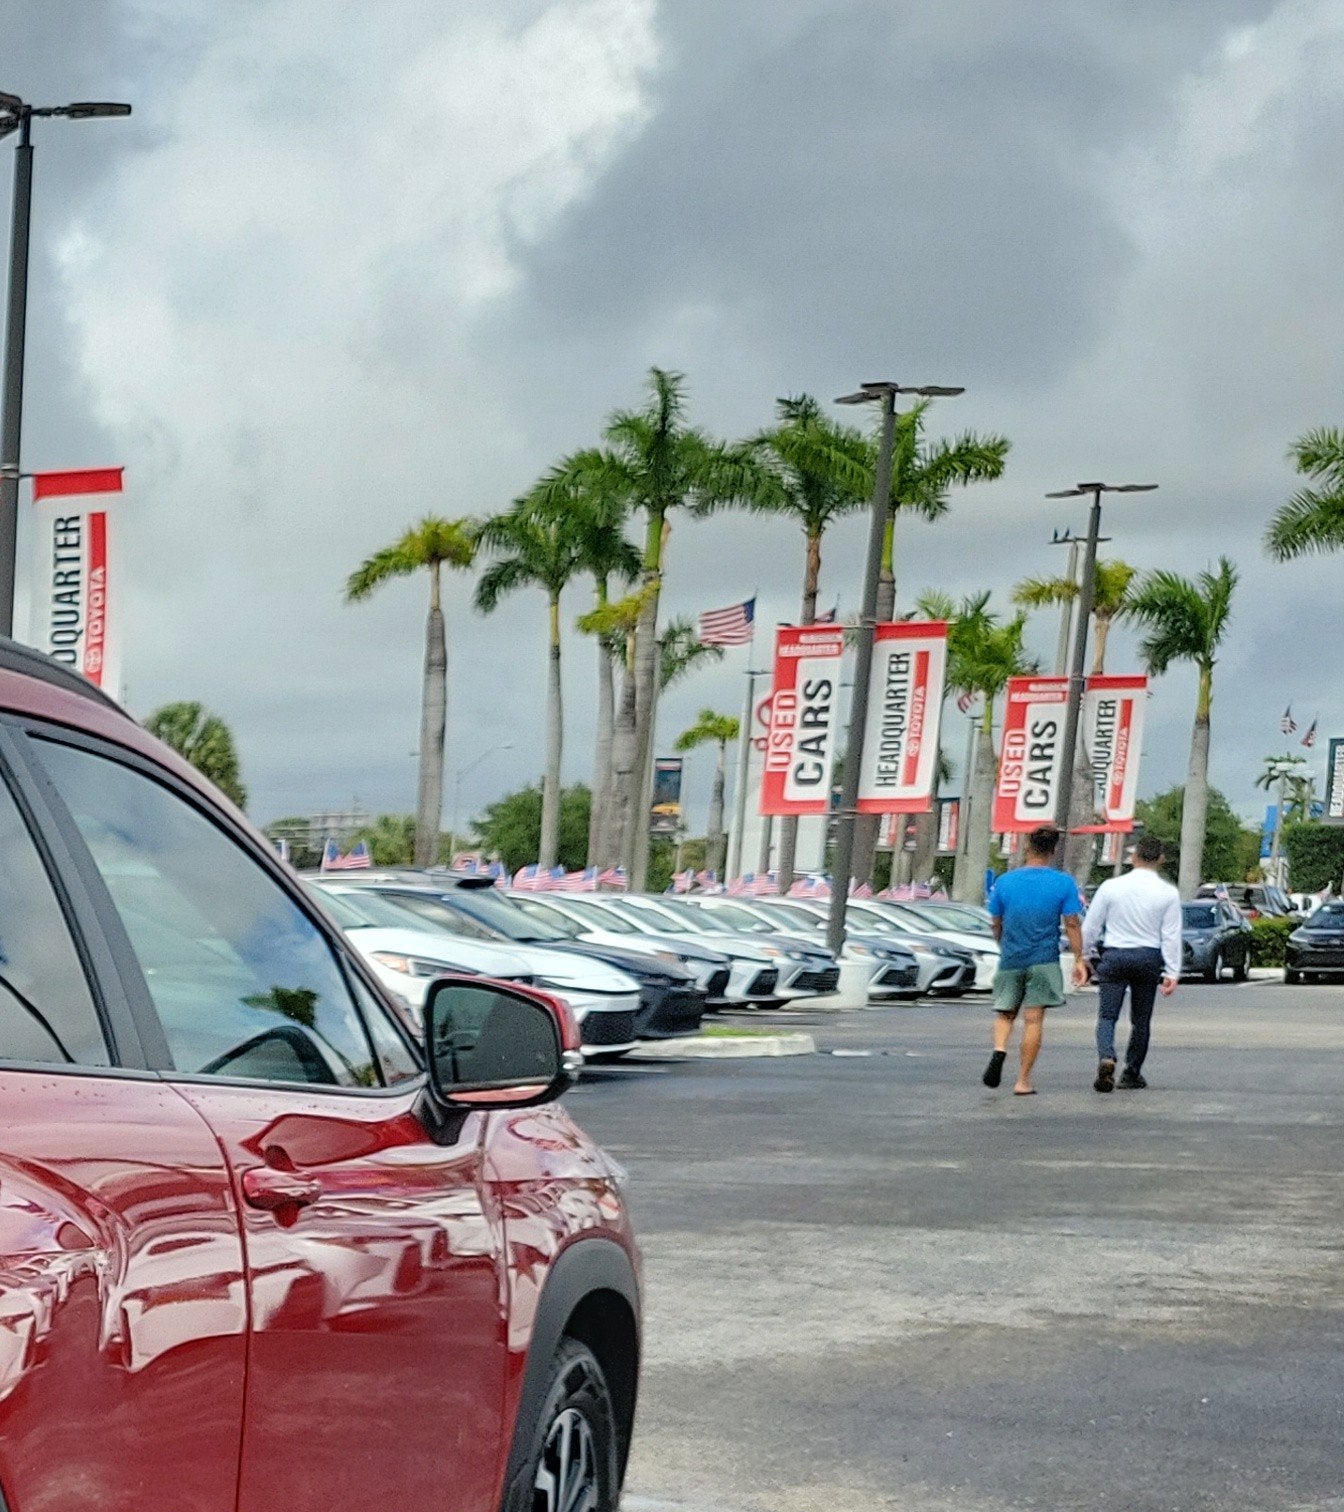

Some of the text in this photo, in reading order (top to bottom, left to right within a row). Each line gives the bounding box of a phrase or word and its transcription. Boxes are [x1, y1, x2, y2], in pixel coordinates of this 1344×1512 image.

[86, 566, 106, 648] TOYOTA
[769, 691, 796, 769] USED
[795, 678, 832, 787] CARS
[875, 652, 910, 787] HEADQUARTER
[1002, 732, 1026, 794] USED
[1023, 720, 1057, 809] CARS
